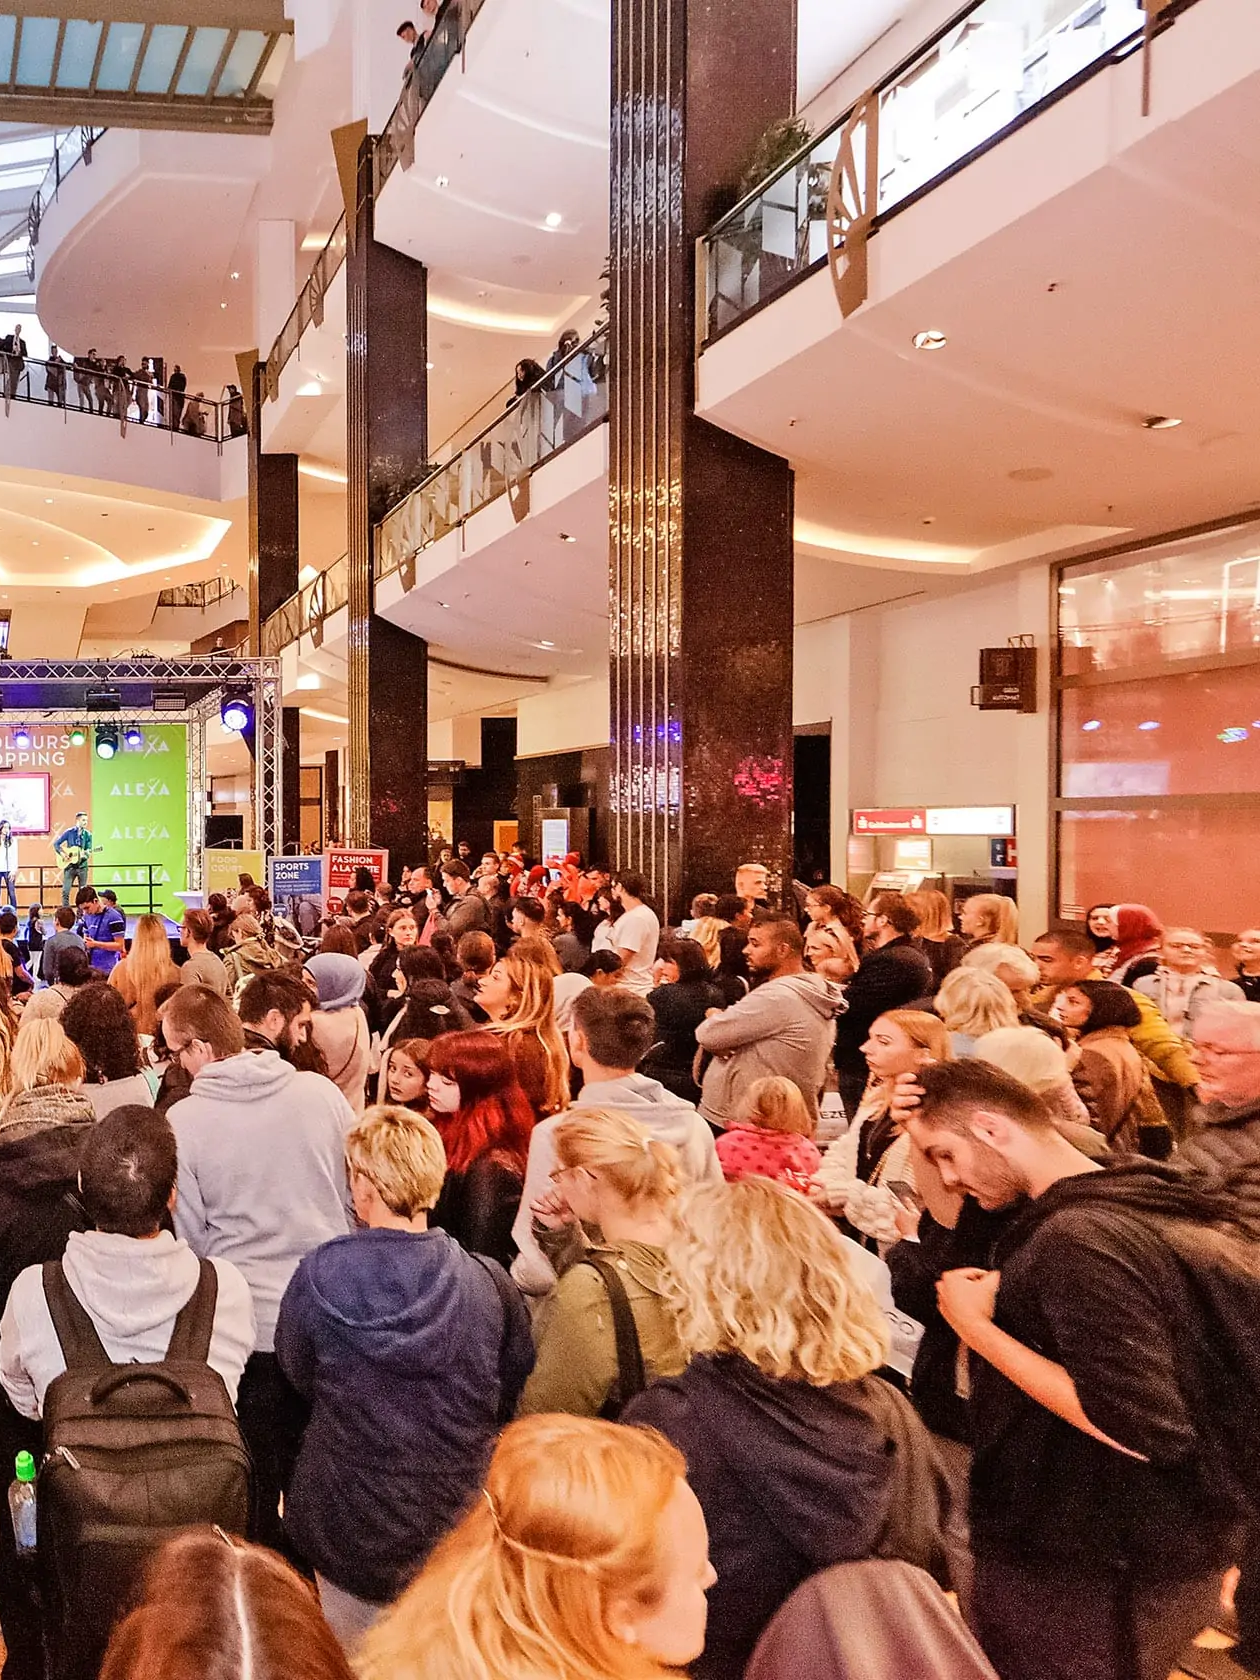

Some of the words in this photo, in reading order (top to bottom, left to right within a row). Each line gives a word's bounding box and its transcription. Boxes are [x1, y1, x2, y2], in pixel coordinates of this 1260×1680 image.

[109, 777, 170, 802] ALEXA
[109, 821, 170, 845] ALEXA
[331, 855, 373, 864] FASHION
[274, 862, 310, 871] SPORTS
[351, 865, 380, 873] CTE
[274, 871, 300, 880] ZONE
